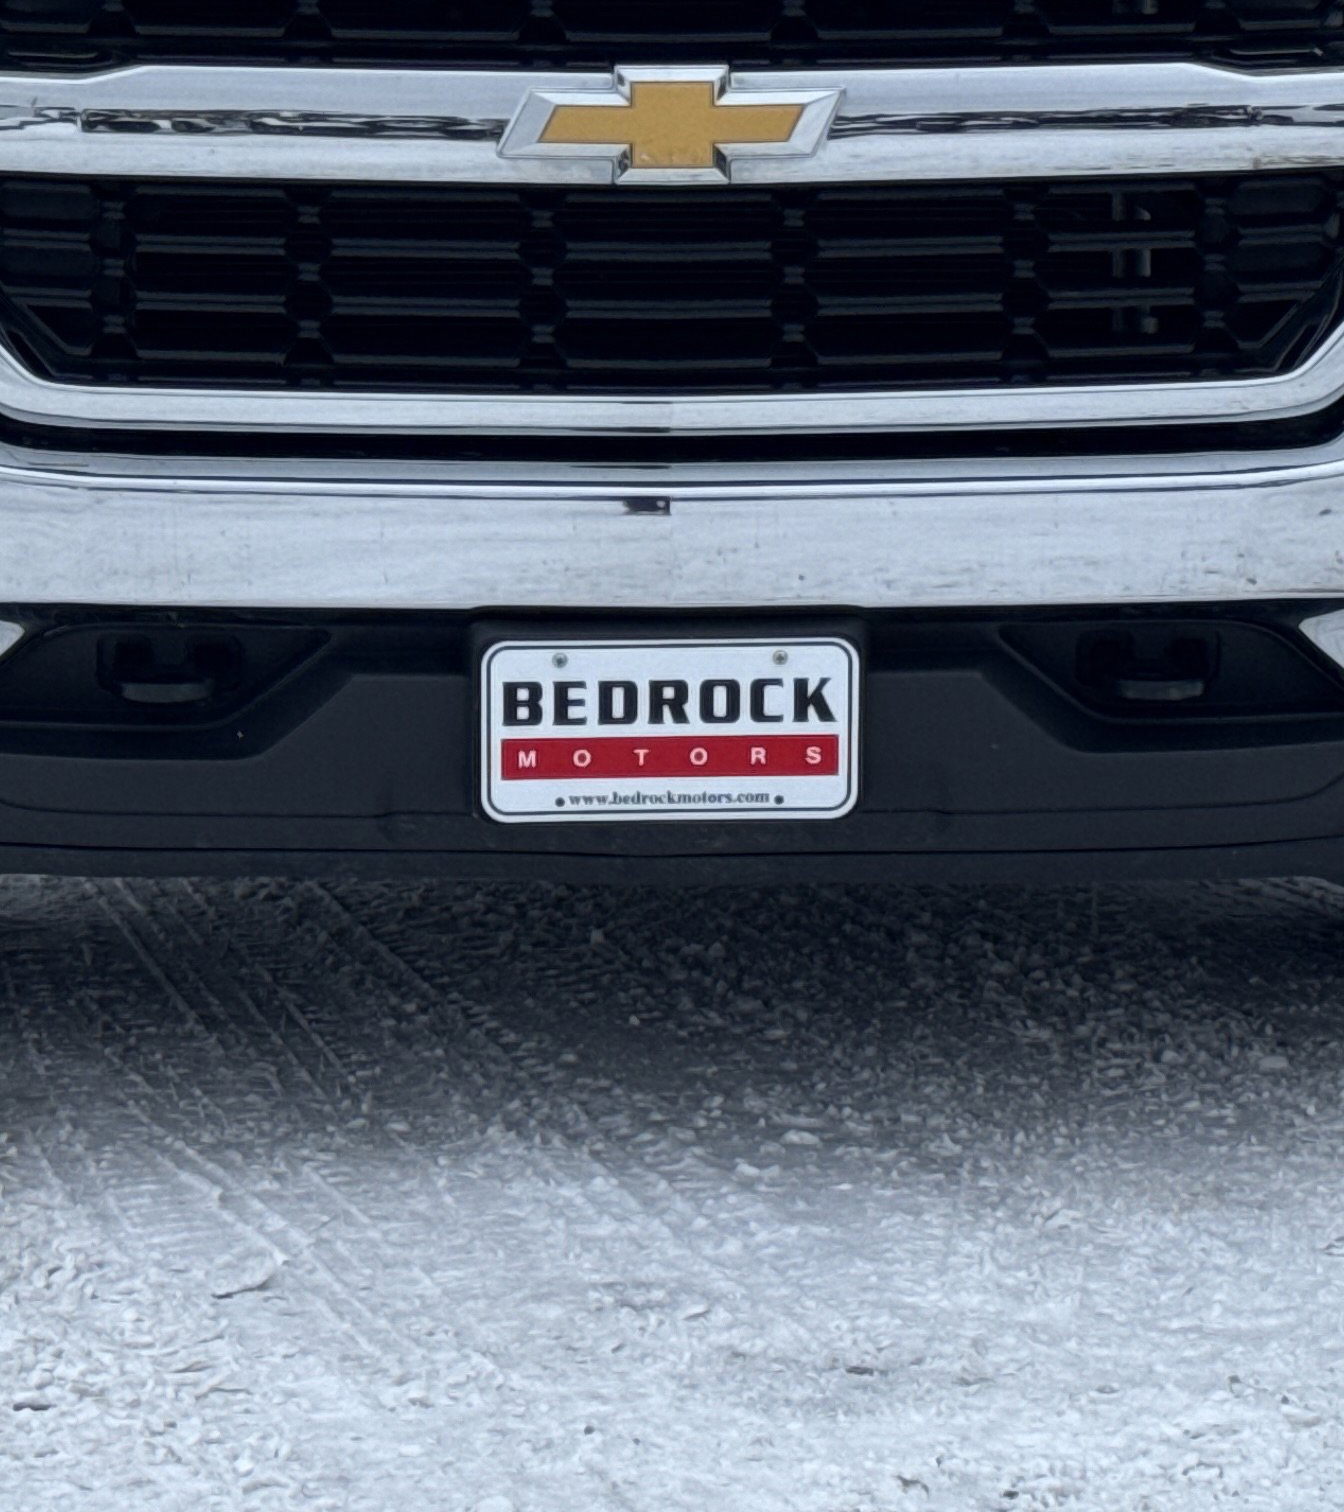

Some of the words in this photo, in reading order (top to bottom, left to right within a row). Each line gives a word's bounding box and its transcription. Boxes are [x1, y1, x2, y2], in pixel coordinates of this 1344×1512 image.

[501, 677, 837, 727] BEDROCK
[517, 746, 822, 769] MOTORS
[568, 790, 771, 806] www.bedrockmotors.com
